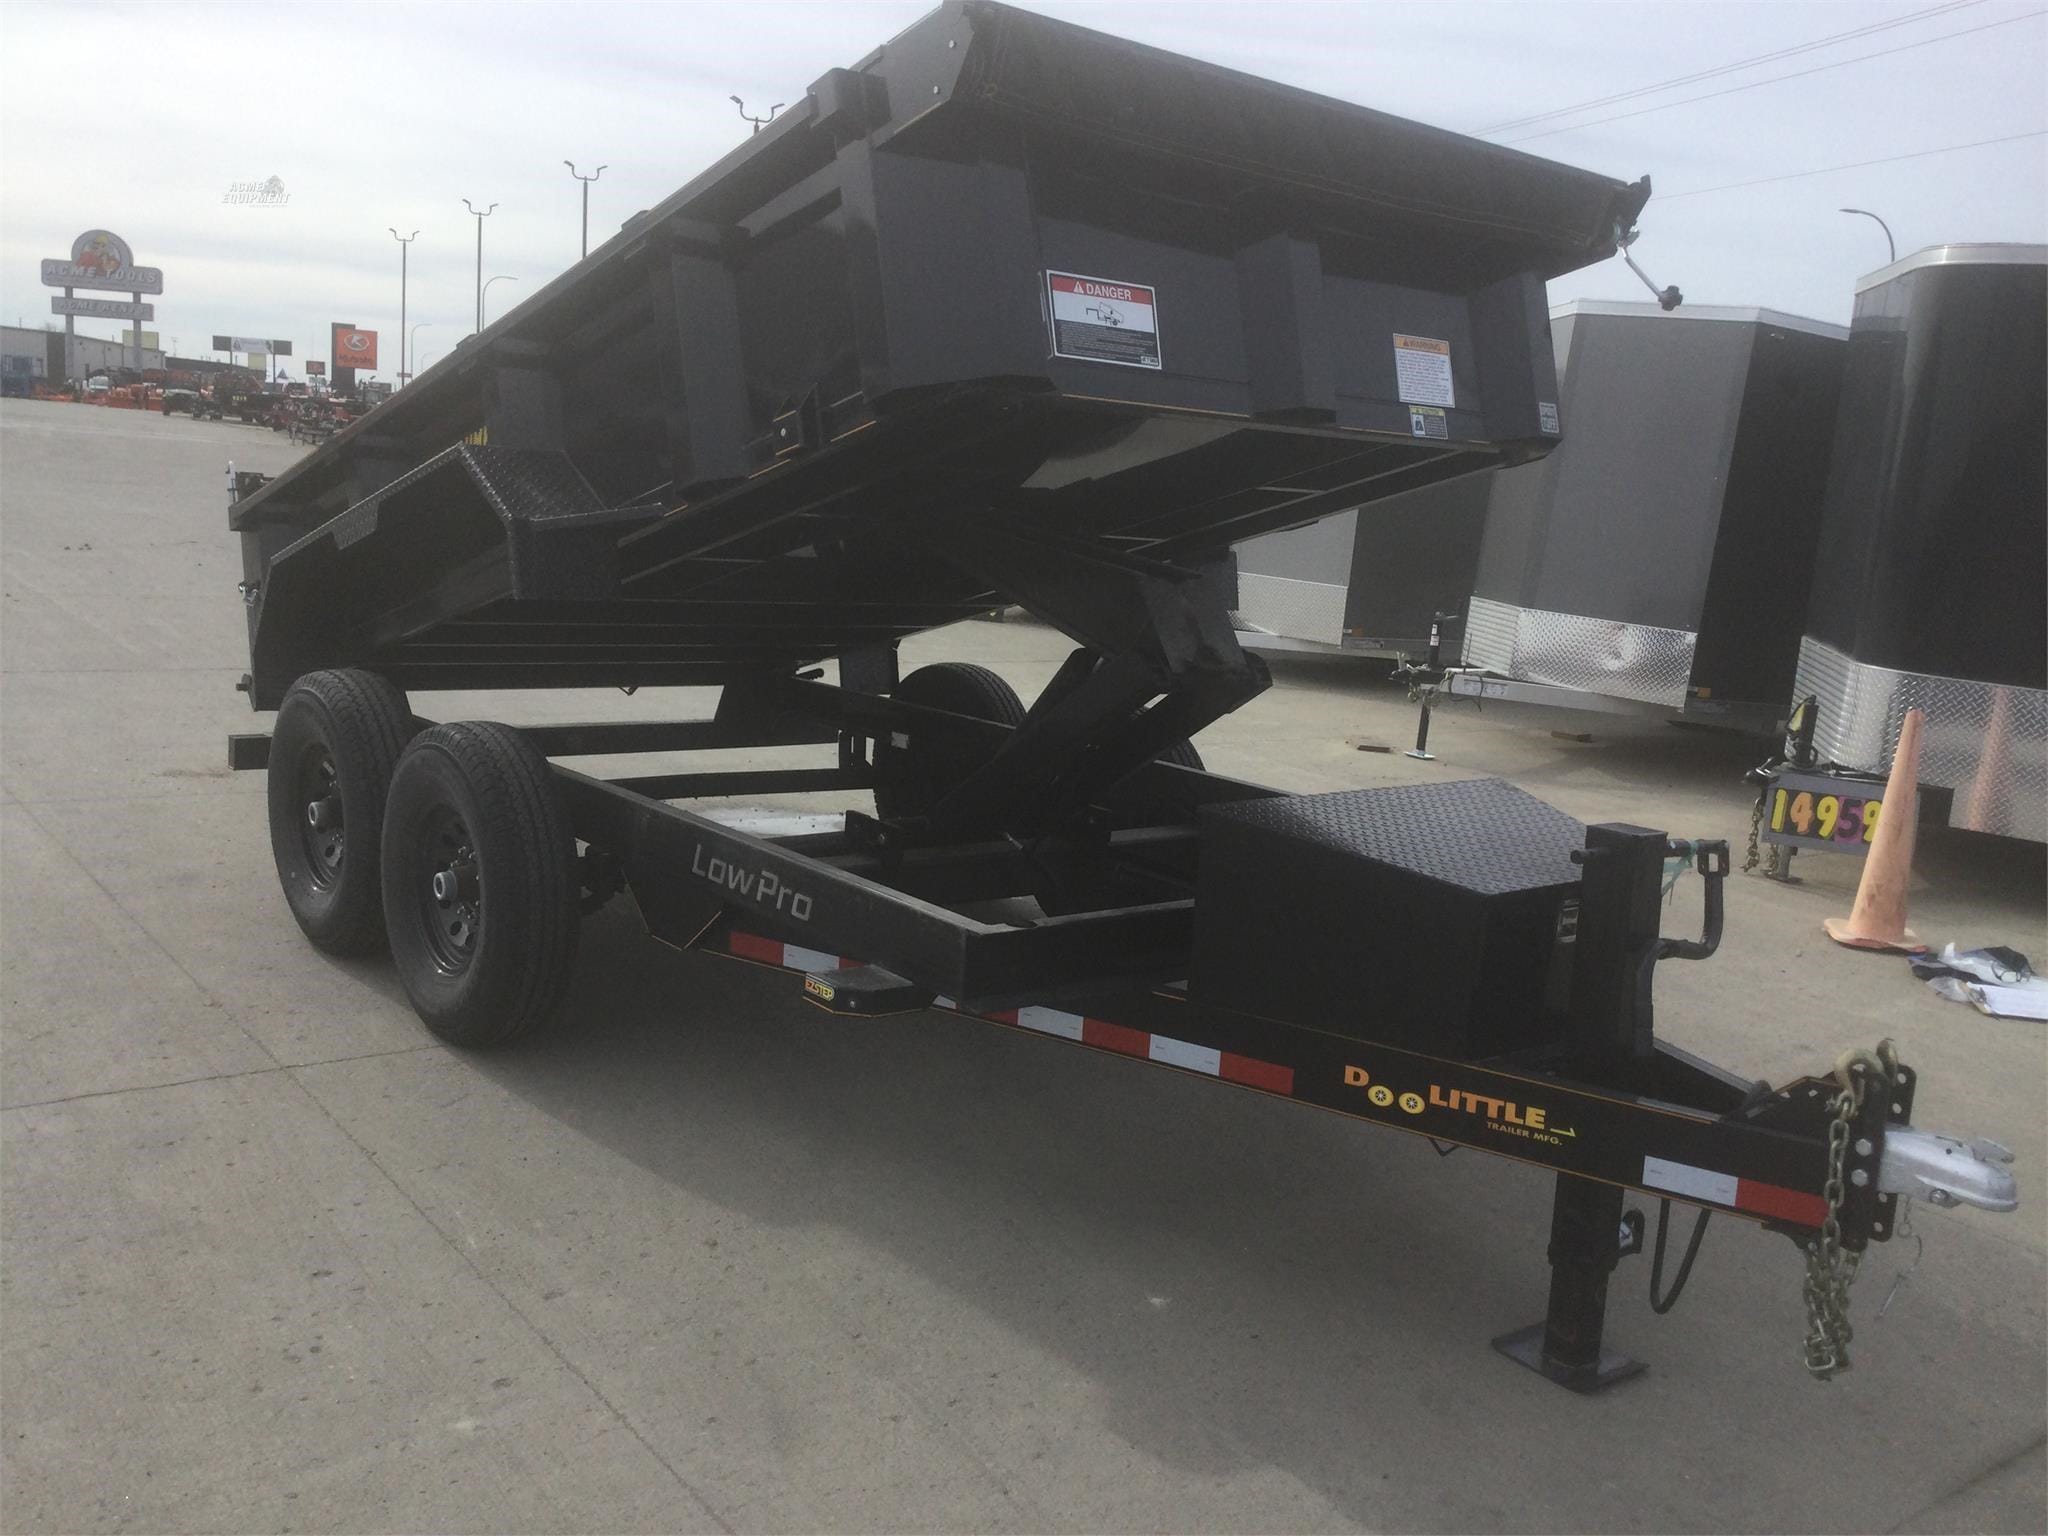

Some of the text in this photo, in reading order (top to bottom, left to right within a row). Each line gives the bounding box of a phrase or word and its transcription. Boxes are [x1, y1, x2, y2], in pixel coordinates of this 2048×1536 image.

[48, 264, 157, 284] ACME TOOLS
[1086, 283, 1132, 301] DANGER
[1771, 788, 1882, 842] 14959
[1486, 1121, 1563, 1146] TRAILER MFG.
